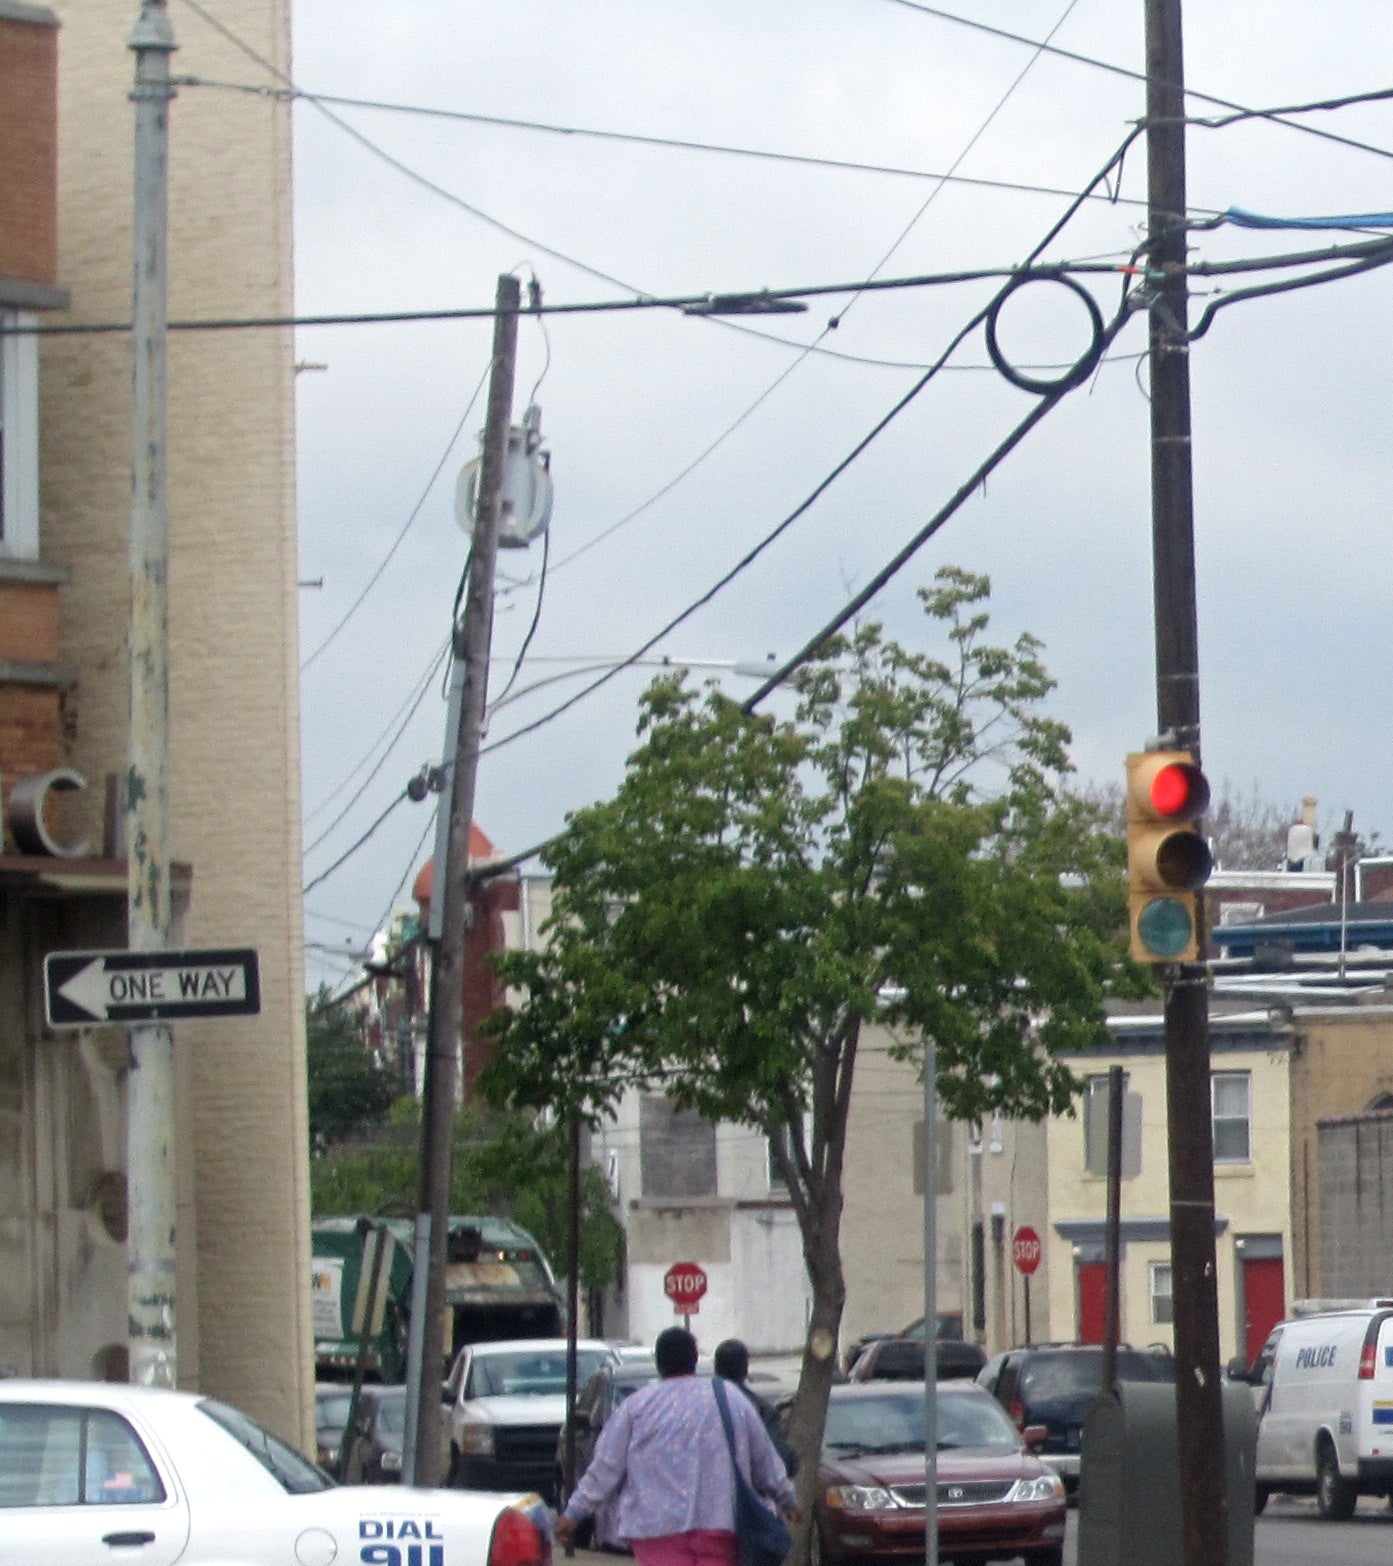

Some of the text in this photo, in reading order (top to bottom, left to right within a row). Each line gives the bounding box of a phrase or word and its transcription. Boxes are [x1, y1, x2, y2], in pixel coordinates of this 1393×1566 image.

[109, 968, 236, 1000] ONE WAY
[1014, 1240, 1040, 1260] STOP
[666, 1274, 705, 1293] STOP
[1296, 1345, 1337, 1369] POLICE
[359, 1520, 444, 1539] DIAL
